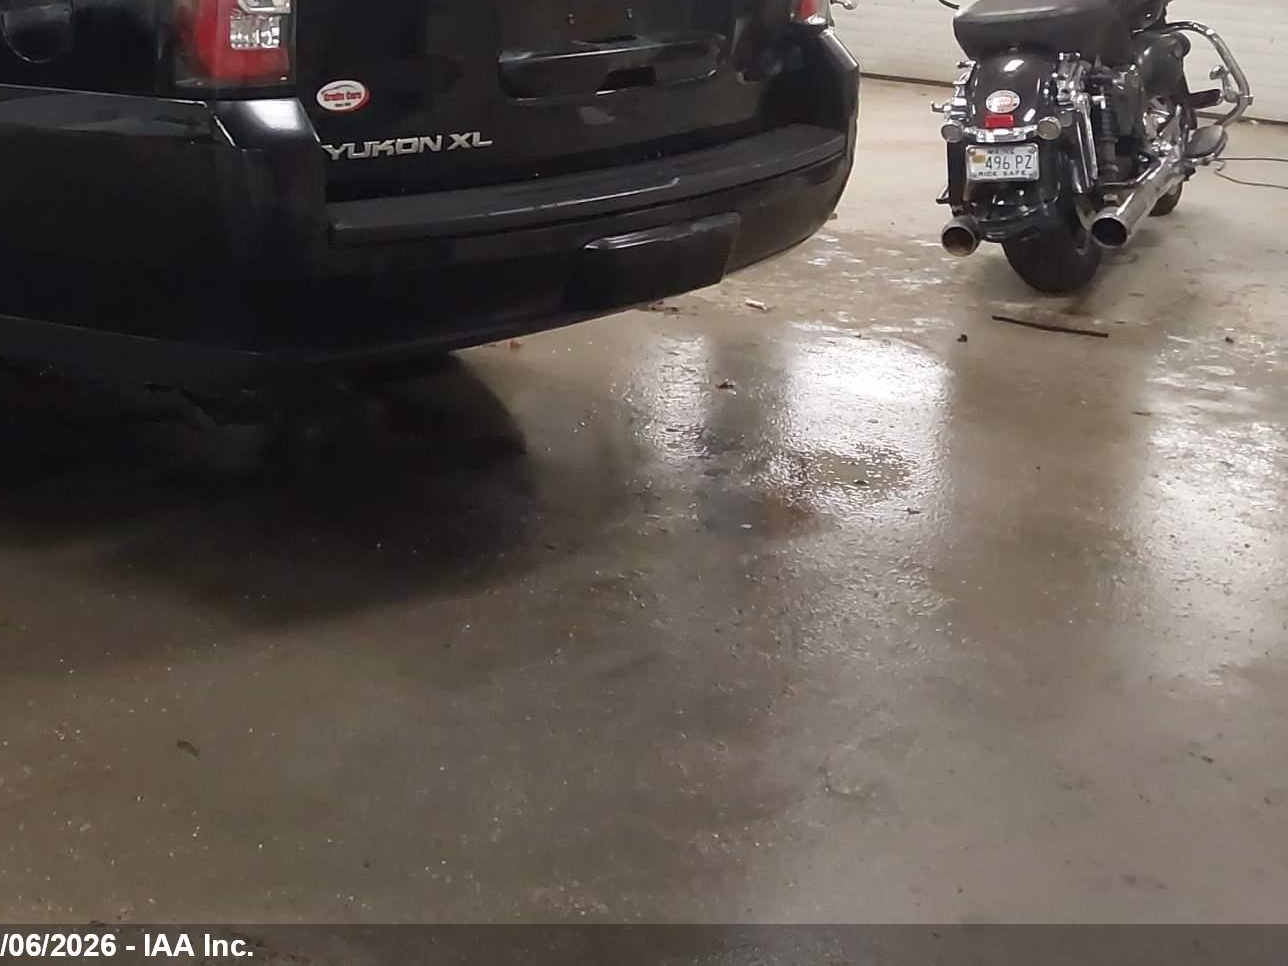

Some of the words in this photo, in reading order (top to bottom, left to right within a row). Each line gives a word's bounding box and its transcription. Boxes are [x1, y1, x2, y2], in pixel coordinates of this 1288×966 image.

[320, 134, 443, 161] YUKON
[447, 131, 493, 151] XL
[985, 154, 1011, 170] 496
[1015, 154, 1032, 170] PZ
